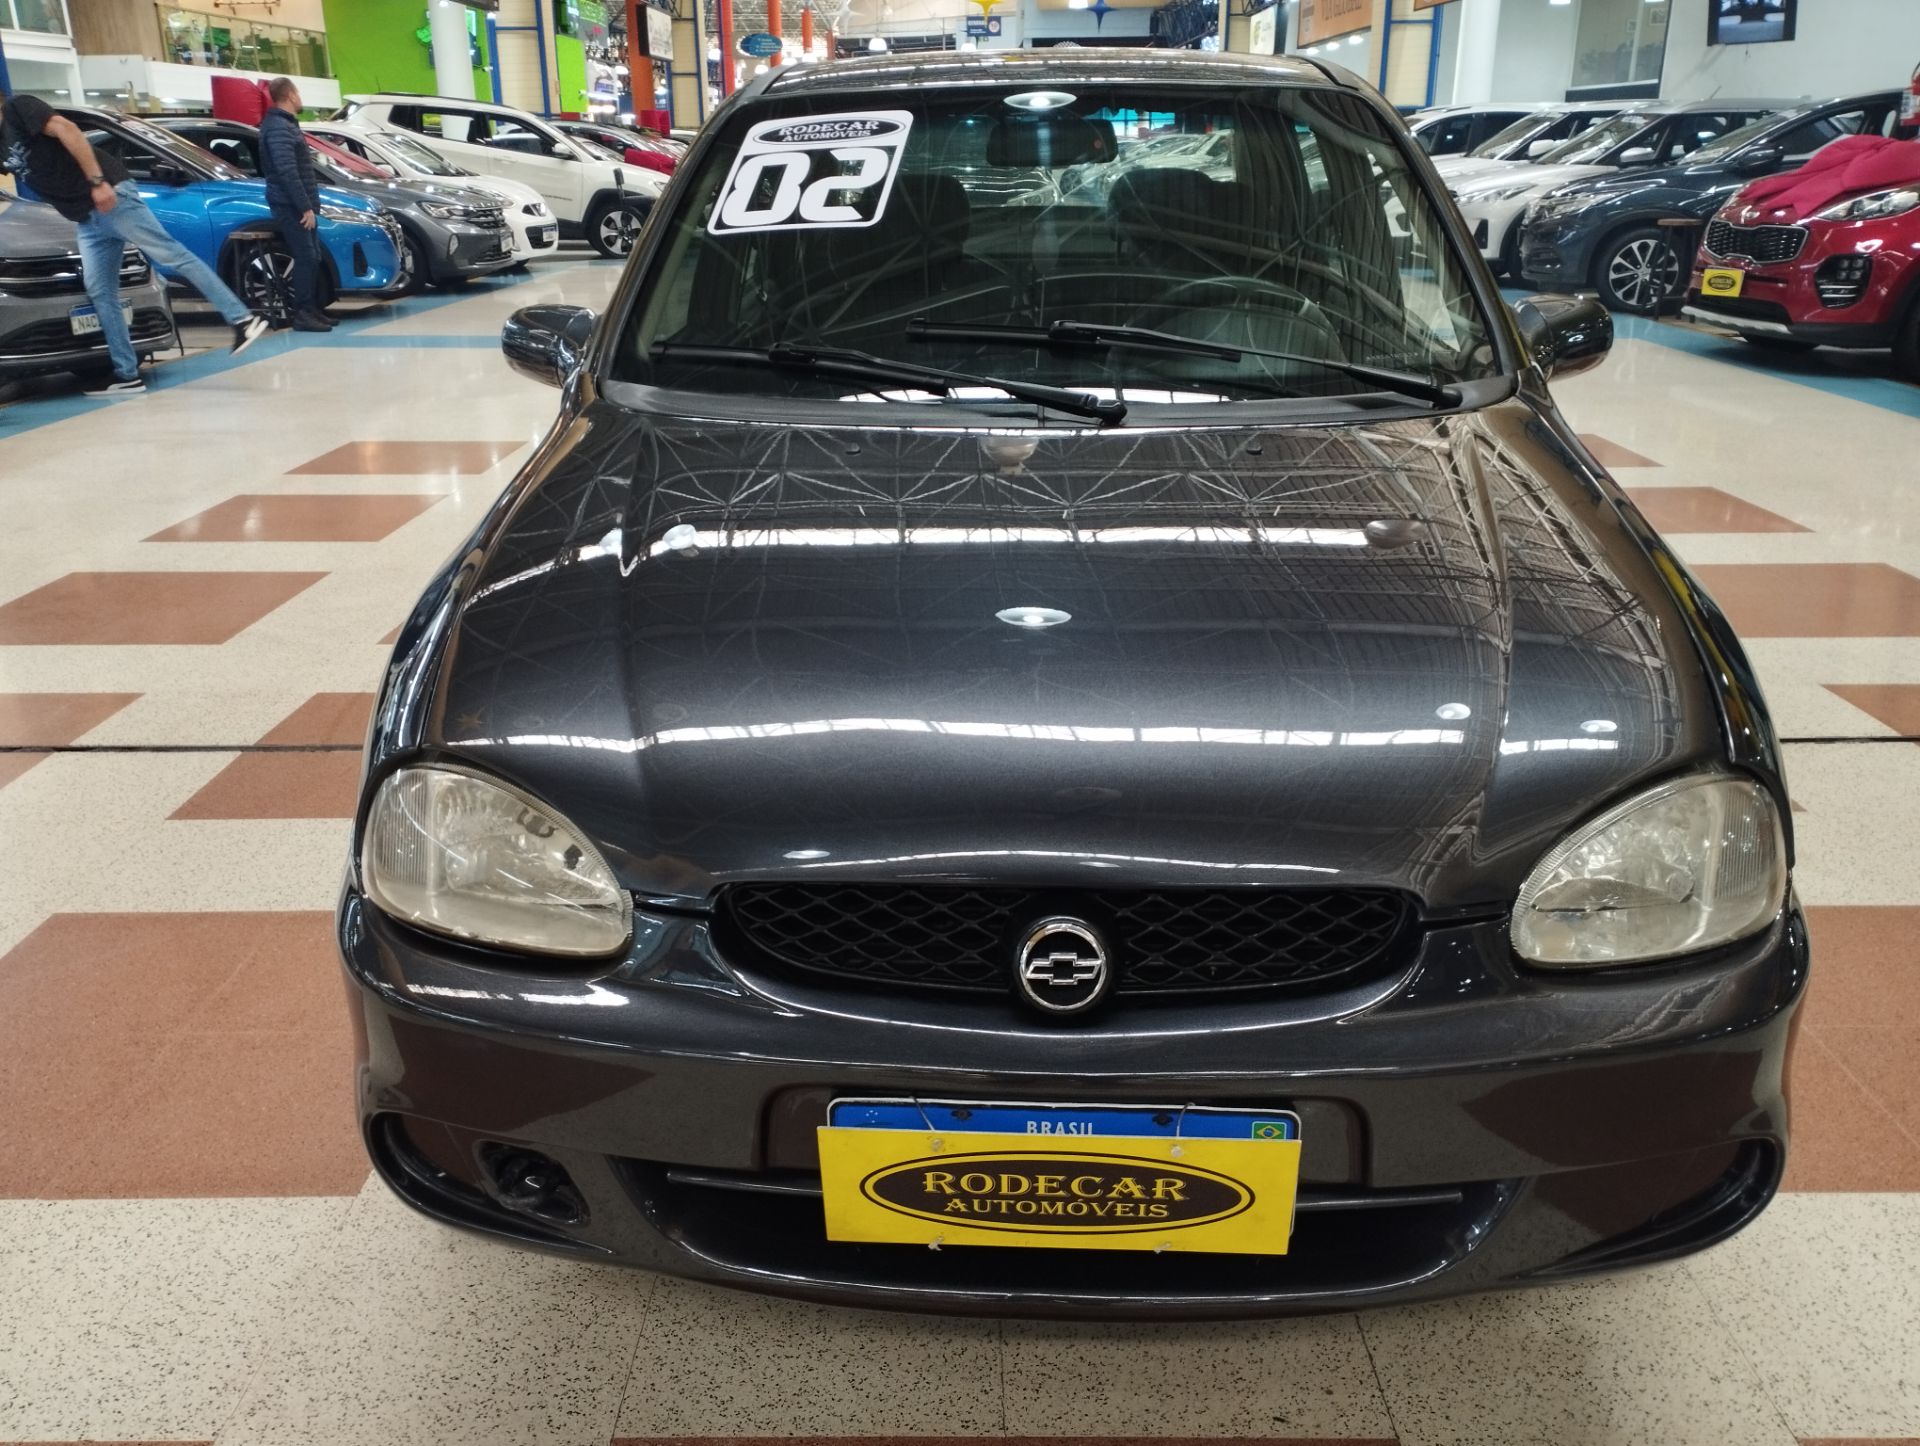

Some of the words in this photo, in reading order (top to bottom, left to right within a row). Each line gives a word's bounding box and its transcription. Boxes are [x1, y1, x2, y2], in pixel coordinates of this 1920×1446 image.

[778, 120, 880, 136] RODECAR
[782, 129, 872, 142] AUTOMÓVEIS
[721, 147, 889, 227] 02
[922, 1170, 1190, 1201] RODECAR
[943, 1197, 1170, 1218] AUTOMÓVEIS
